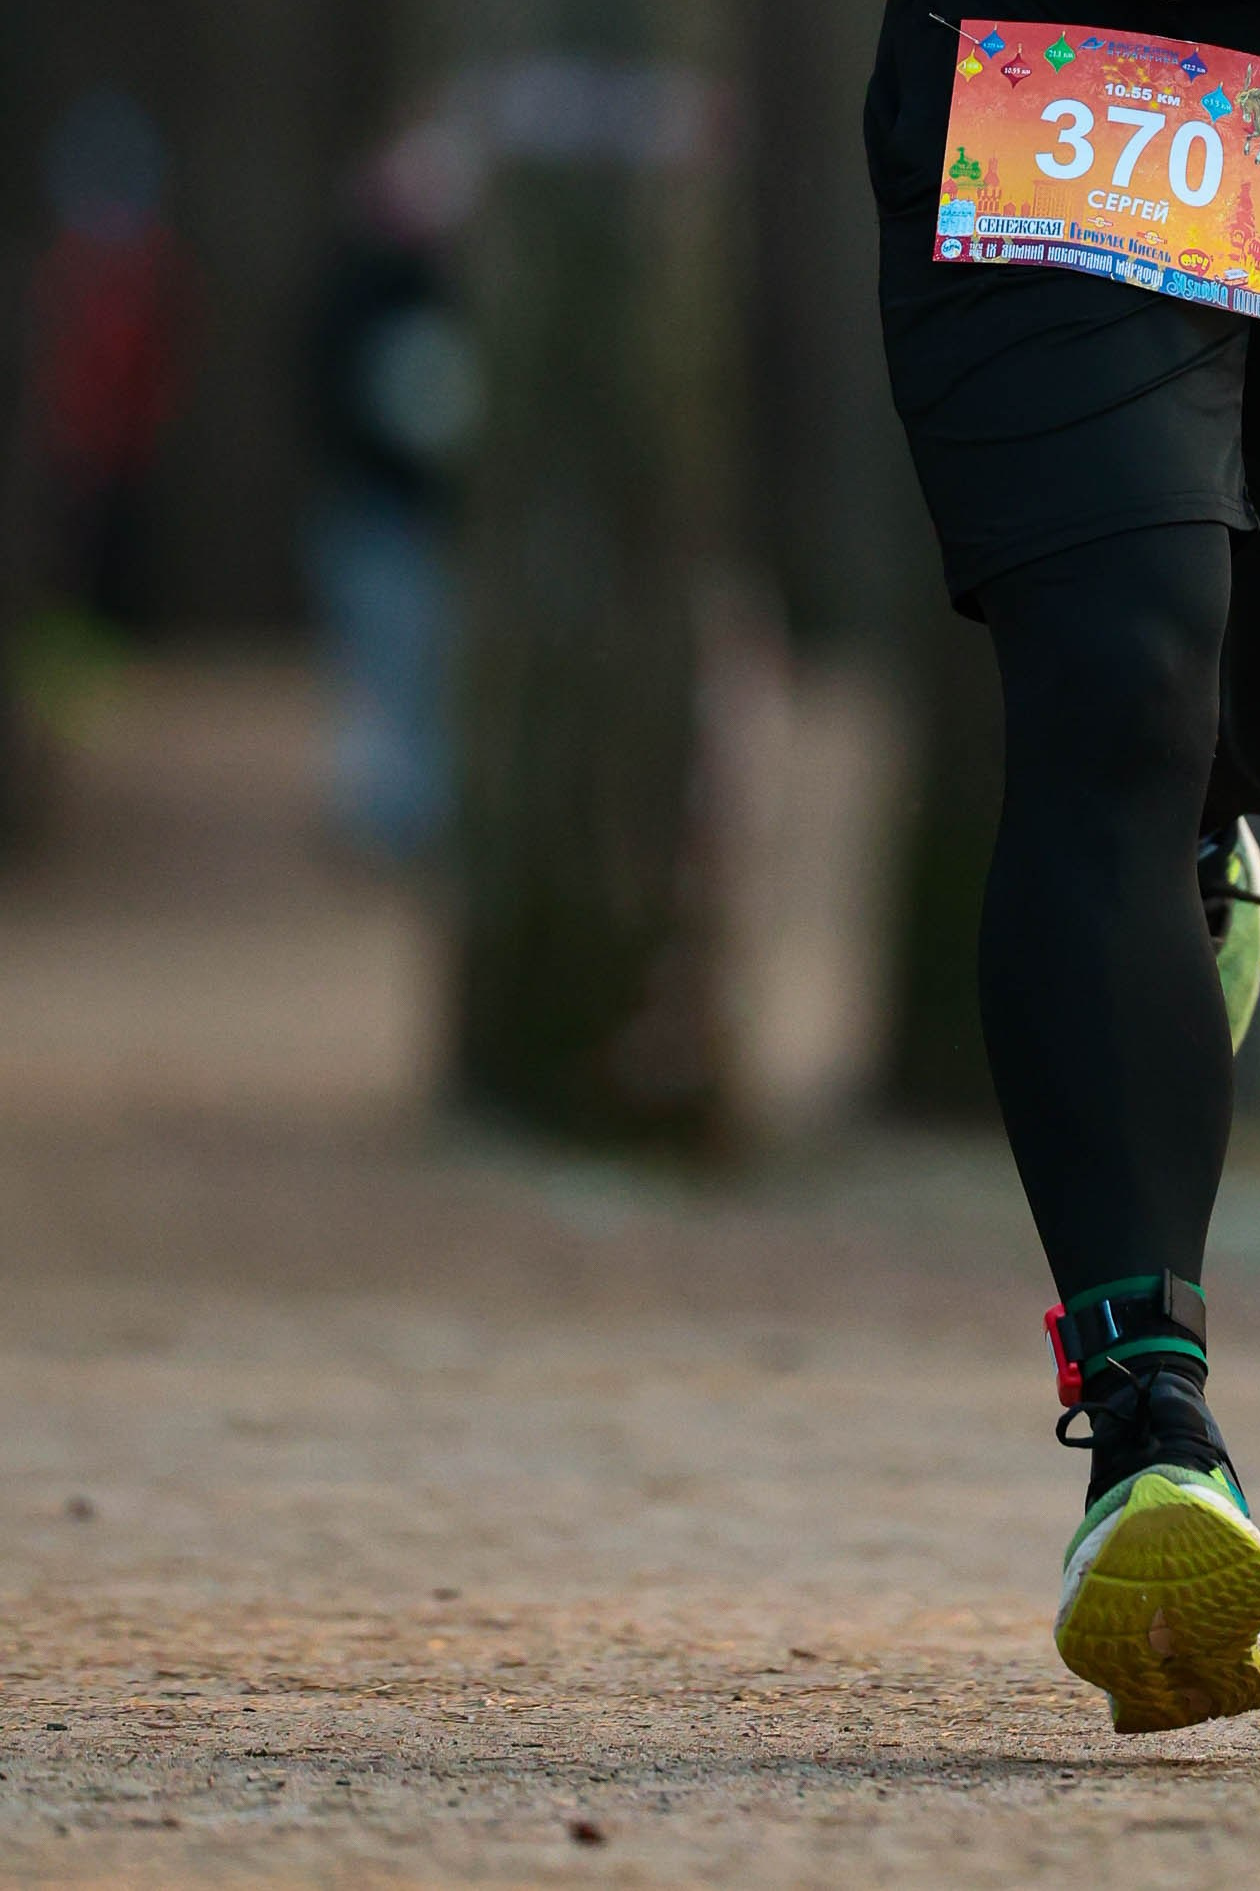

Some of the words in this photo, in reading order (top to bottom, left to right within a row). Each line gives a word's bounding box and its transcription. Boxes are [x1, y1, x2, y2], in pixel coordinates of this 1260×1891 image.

[1104, 82, 1153, 101] 10.55
[1034, 98, 1225, 208] 370
[1087, 190, 1169, 224] СЕРГЕЙ
[977, 217, 1063, 237] СЕНЕЖСКАЯ
